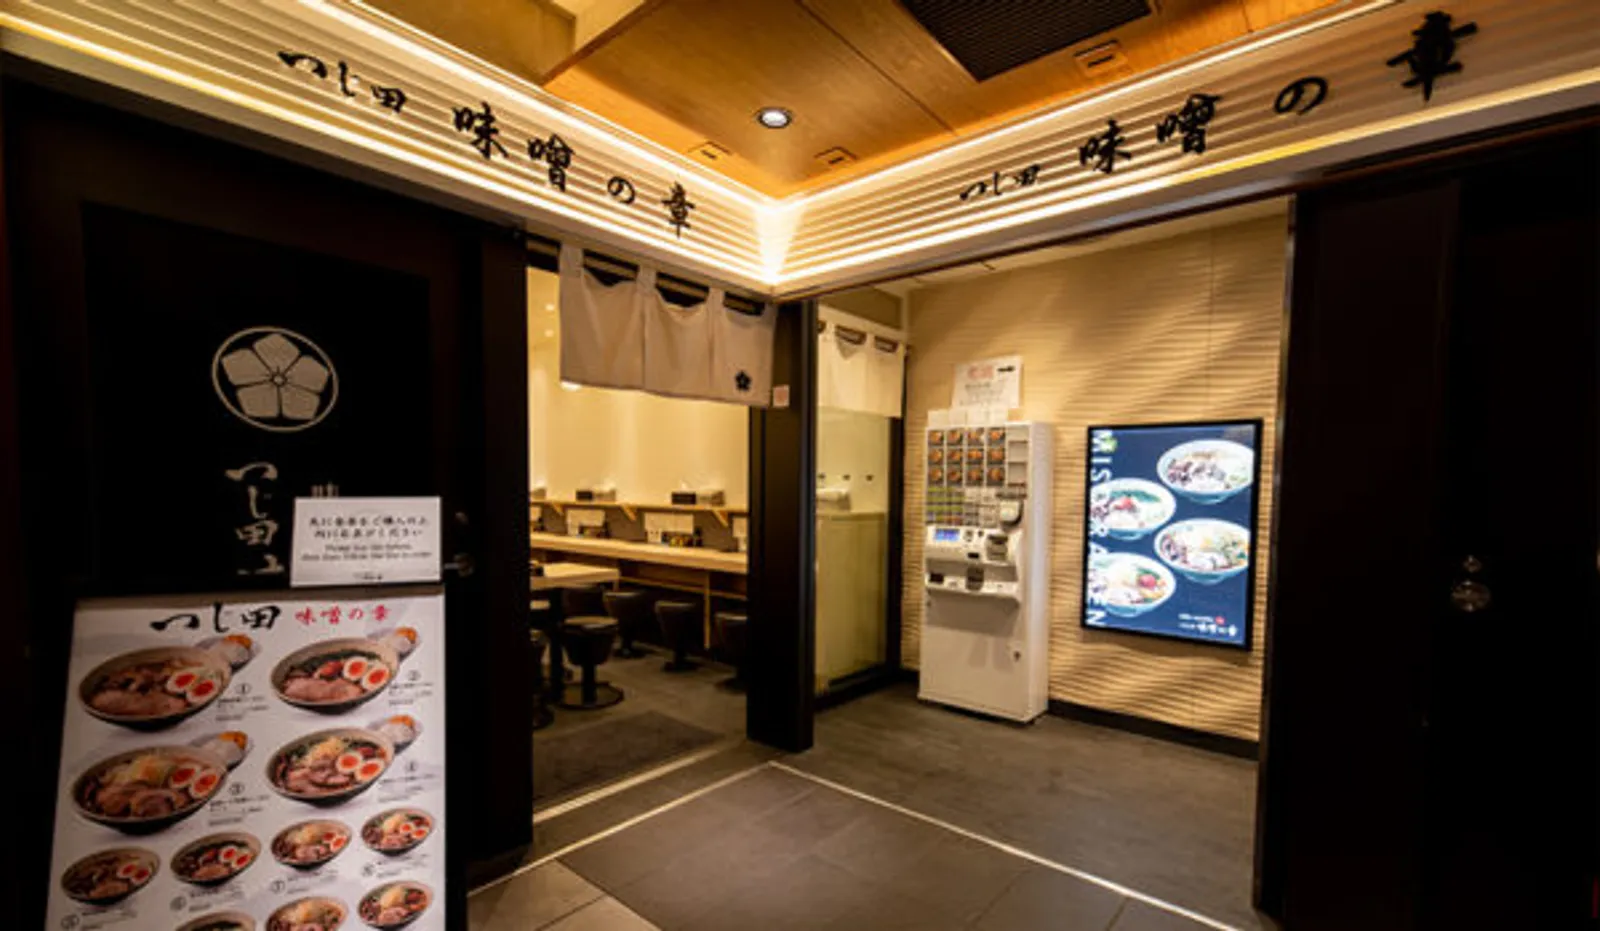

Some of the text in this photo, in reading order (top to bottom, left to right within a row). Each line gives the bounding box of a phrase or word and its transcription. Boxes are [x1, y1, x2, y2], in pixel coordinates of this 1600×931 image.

[277, 50, 696, 238] つじ田 味噌の章
[959, 10, 1478, 201] つじ田 味噌の章
[150, 600, 393, 633] つじ田 味噌の章
[1086, 519, 1110, 626] RAEN
